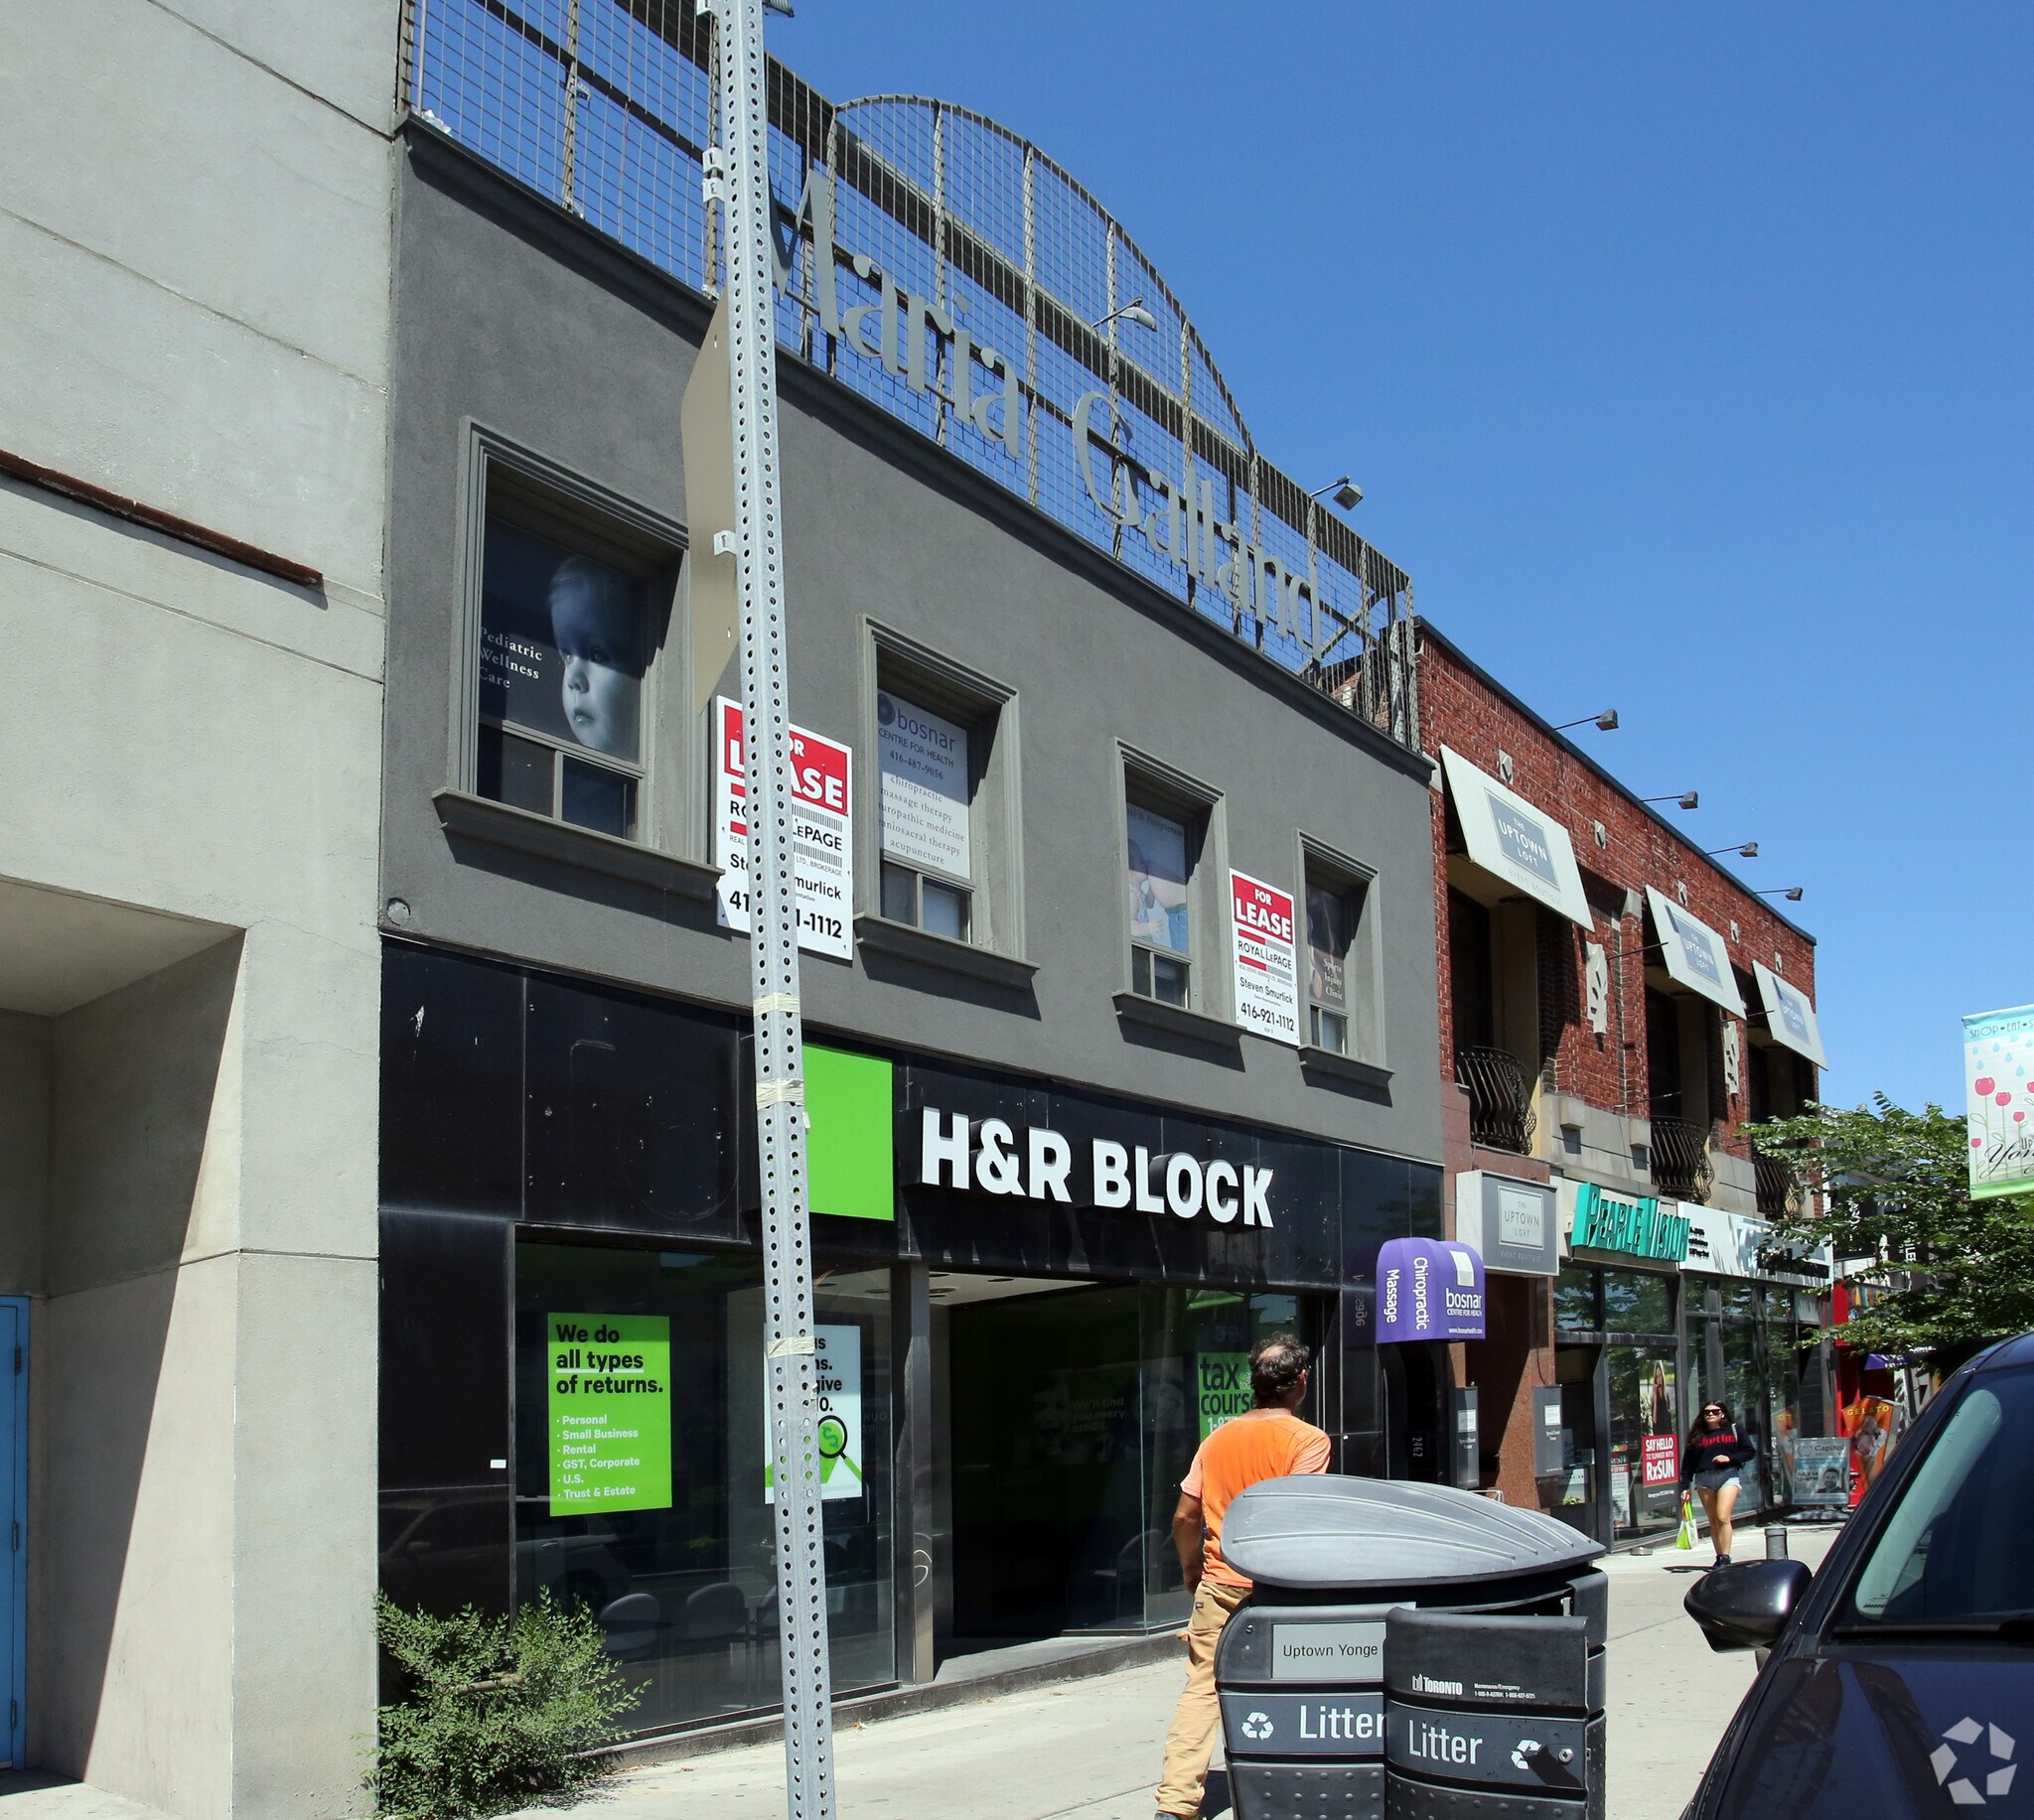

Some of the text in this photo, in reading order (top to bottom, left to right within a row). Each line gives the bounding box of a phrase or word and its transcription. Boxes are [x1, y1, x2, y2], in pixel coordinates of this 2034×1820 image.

[1073, 390, 1323, 663] Galland
[897, 708, 955, 752] bosnar
[879, 728, 953, 769] CENTRE FOR HEALTH
[890, 774, 944, 803] chiropractic
[881, 787, 952, 824] massage therapy
[793, 825, 842, 852] EPAGE
[927, 820, 965, 842] medicine
[1498, 818, 1548, 862] UPTOWN
[890, 839, 945, 865] acupuncture
[929, 836, 960, 857] therapy
[1517, 847, 1538, 868] LOFT
[1254, 888, 1272, 906] FOR
[1235, 897, 1291, 941] LEASE
[1237, 939, 1265, 960] ROYAL
[1682, 937, 1715, 966] UPTOWN
[1239, 976, 1264, 994] Steven
[1264, 985, 1294, 1006] Smurlick
[1240, 1002, 1295, 1032] 416-921-1112
[1969, 1025, 1999, 1039] SHOP
[2006, 1022, 2022, 1033] EAT
[922, 1105, 1275, 1229] H&R BLOCK
[1517, 1200, 1526, 1209] THE
[1504, 1209, 1539, 1227] UPTOWN
[1574, 1182, 1644, 1255] PEARLE
[1514, 1228, 1530, 1238] LOFT
[1640, 1197, 1690, 1262] VISION
[1383, 1269, 1400, 1324] Massage
[1412, 1256, 1430, 1331] Chiropractic
[1446, 1287, 1483, 1310] bosnar
[555, 1325, 621, 1343] We do
[555, 1348, 644, 1373] all types
[555, 1373, 663, 1394] of returns.
[1200, 1357, 1240, 1391] tax
[562, 1414, 608, 1426] Personal
[1847, 1405, 1890, 1416] GELATO
[562, 1428, 639, 1440] Small Business
[1646, 1437, 1673, 1452] SAY HELLO
[562, 1443, 597, 1455] Rental
[1411, 1437, 1423, 1459] 2462
[1652, 1452, 1666, 1461] SUMMER
[1814, 1444, 1845, 1453] Capitol
[562, 1456, 641, 1470] GST, Corporate
[1646, 1459, 1675, 1481] RxSUN
[562, 1473, 584, 1484] U.S.
[563, 1484, 636, 1499] Trust & Estate
[1283, 1642, 1379, 1660] Uptown Yonge
[1423, 1676, 1463, 1696] TORONTO
[1299, 1705, 1384, 1739] Litter
[1408, 1719, 1484, 1765] Litter
